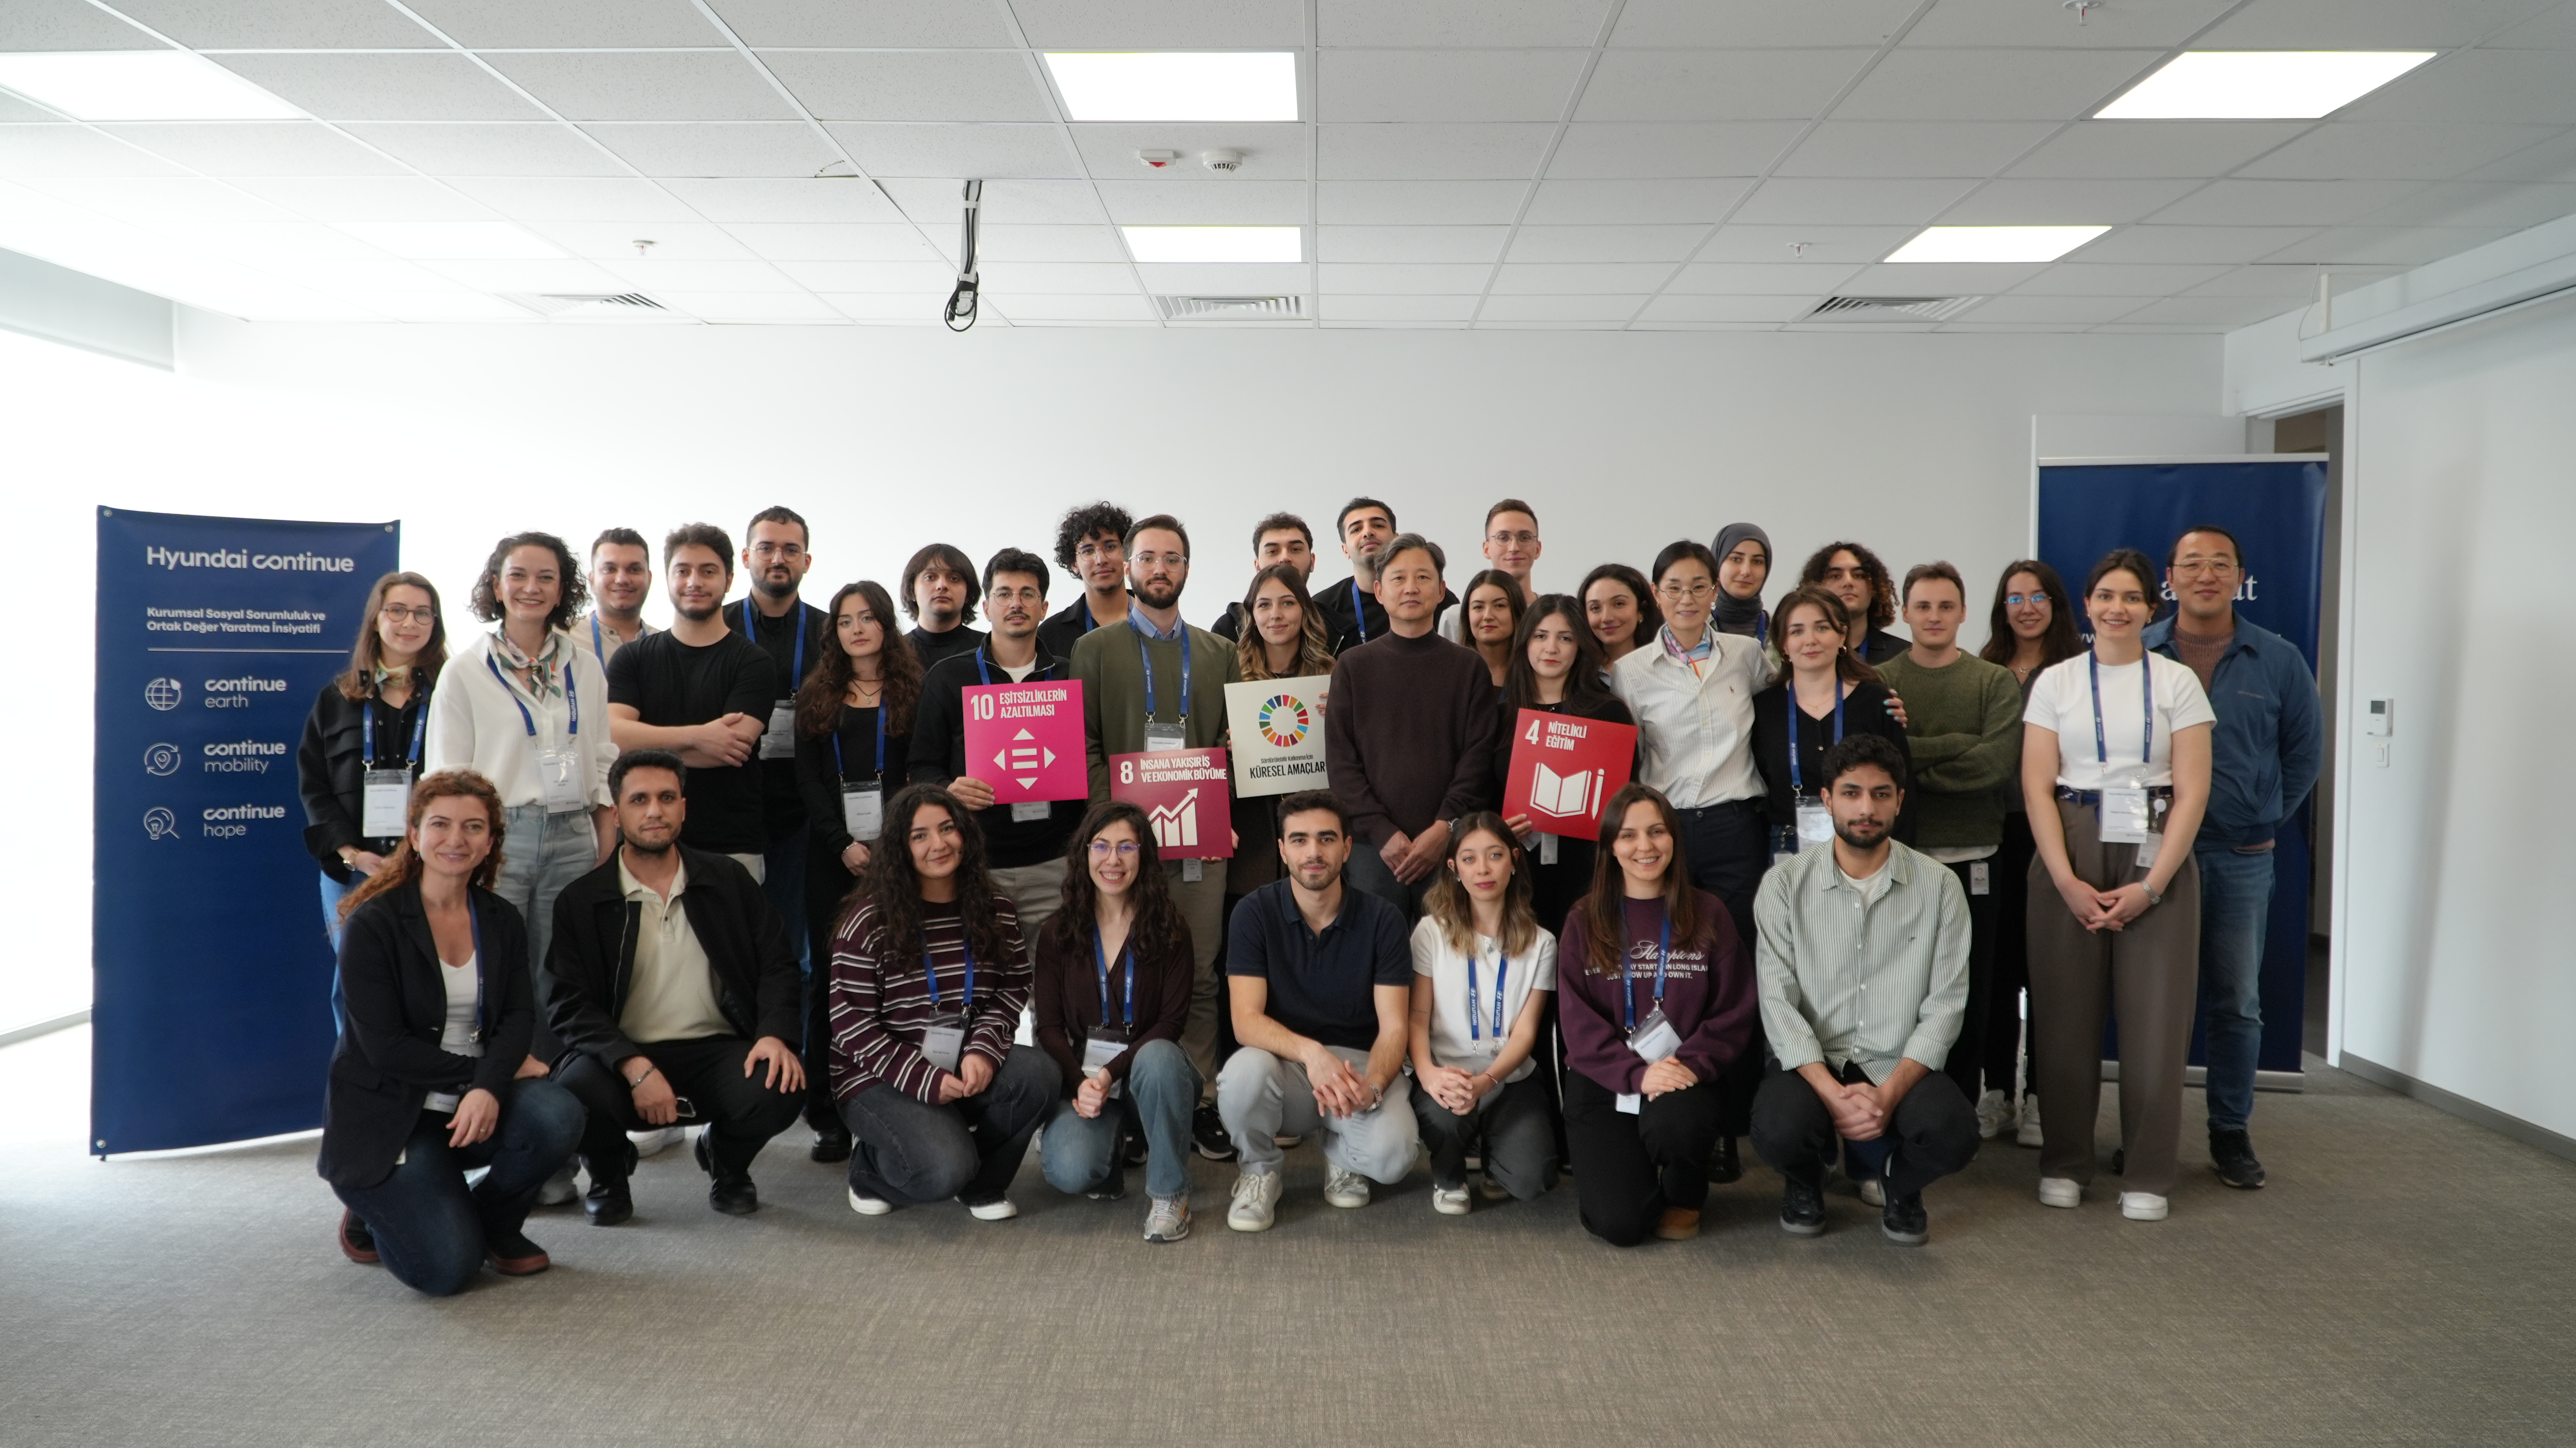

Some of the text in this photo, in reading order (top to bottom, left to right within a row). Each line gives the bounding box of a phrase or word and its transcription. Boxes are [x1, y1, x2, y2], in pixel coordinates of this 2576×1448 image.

[147, 546, 354, 573] Hyundai continue
[147, 607, 325, 621] Kurumsal Sosyal Sorumluluk ve
[146, 620, 321, 635] Ortak Değer Yaratma İnsiyatifi
[204, 676, 287, 692] continue
[204, 694, 248, 708] earth
[1000, 688, 1067, 705] EŞİTSİZLİKLERİN
[971, 694, 994, 720] 10
[1001, 704, 1055, 719] AZALTILMASI
[1525, 719, 1540, 745] 4
[1548, 721, 1588, 739] NİTELİKLİ
[203, 740, 286, 756] continue
[1546, 734, 1575, 751] EĞİTİM
[204, 758, 269, 774] mobility
[1140, 755, 1210, 770] İNSANA YAKIŞIR İŞ
[1250, 761, 1325, 779] KÜRESEL AMAÇLAR
[1120, 761, 1134, 784] 8
[1141, 767, 1227, 783] VE EKONOMİK BÜYÜME
[203, 804, 286, 821] continue
[203, 823, 246, 839] hope
[1630, 941, 1705, 962] Haptons
